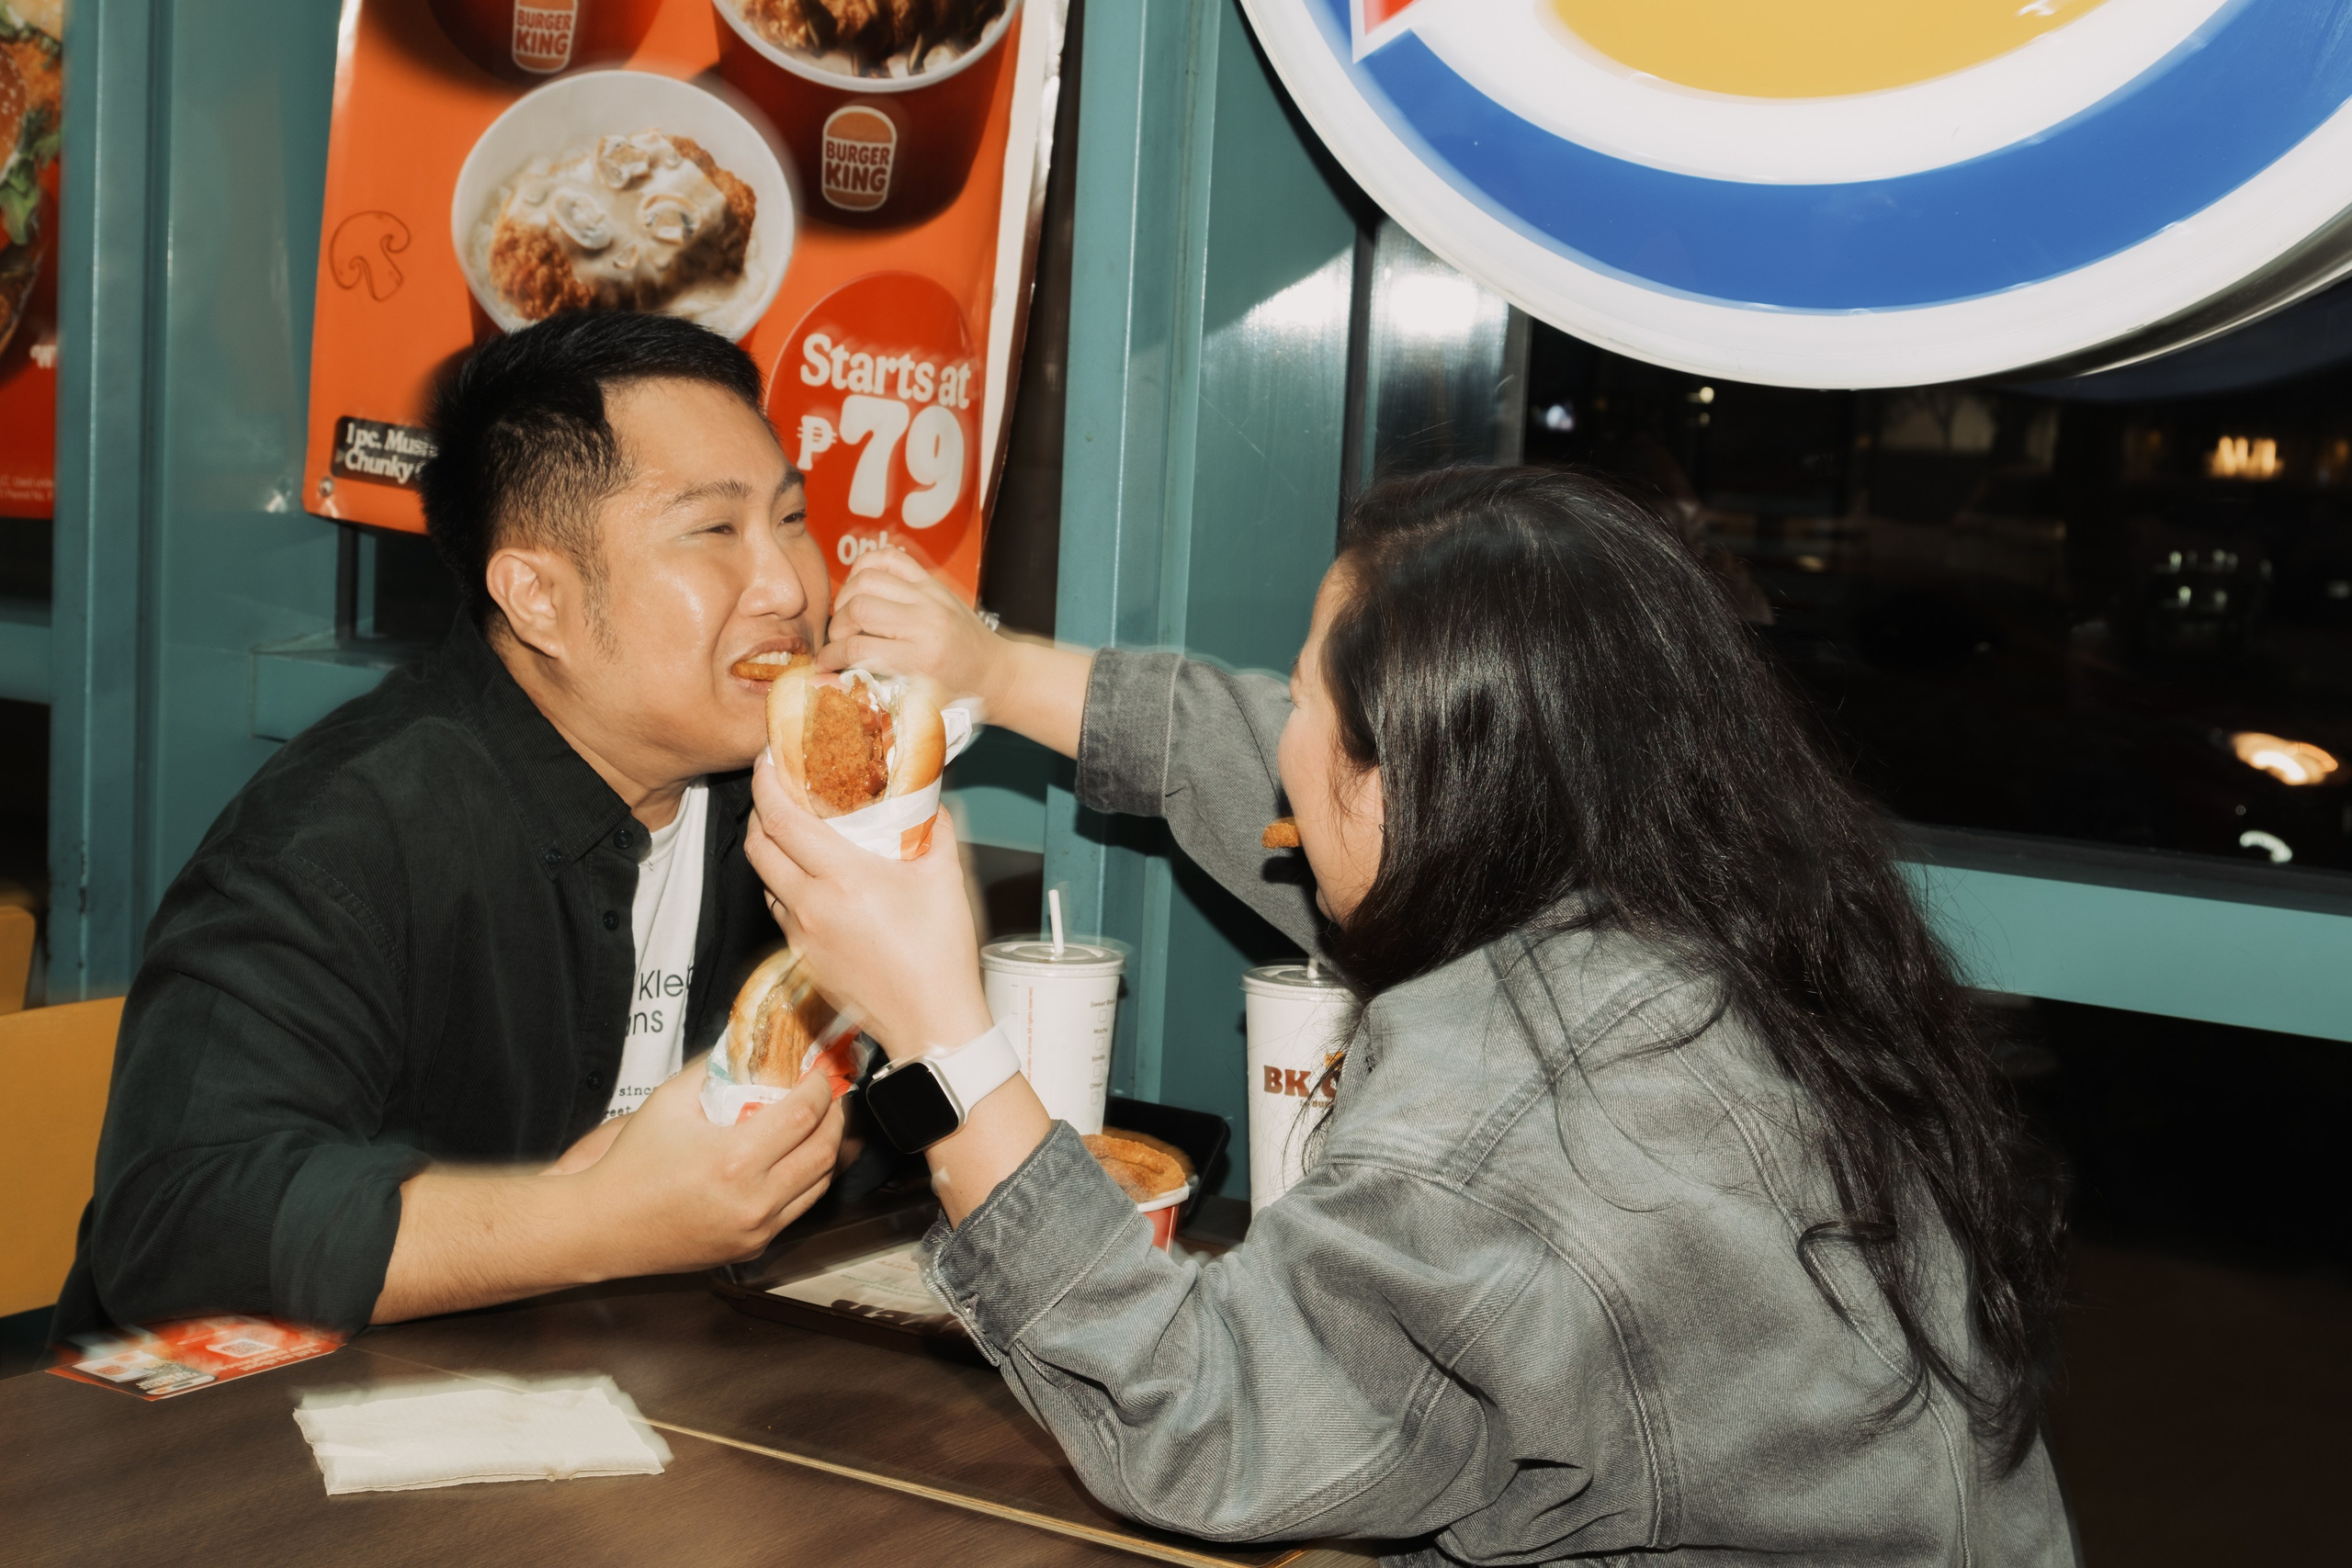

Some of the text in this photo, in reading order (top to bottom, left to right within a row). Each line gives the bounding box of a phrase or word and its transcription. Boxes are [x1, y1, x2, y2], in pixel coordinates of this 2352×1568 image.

[517, 9, 571, 31] BURGER
[516, 28, 569, 55] KING
[826, 141, 890, 165] BURGER
[825, 161, 887, 192] KING
[800, 333, 971, 410] Starts at
[345, 447, 415, 484] Chunky
[619, 1086, 657, 1096] sinc
[1263, 1066, 1312, 1098] BK
